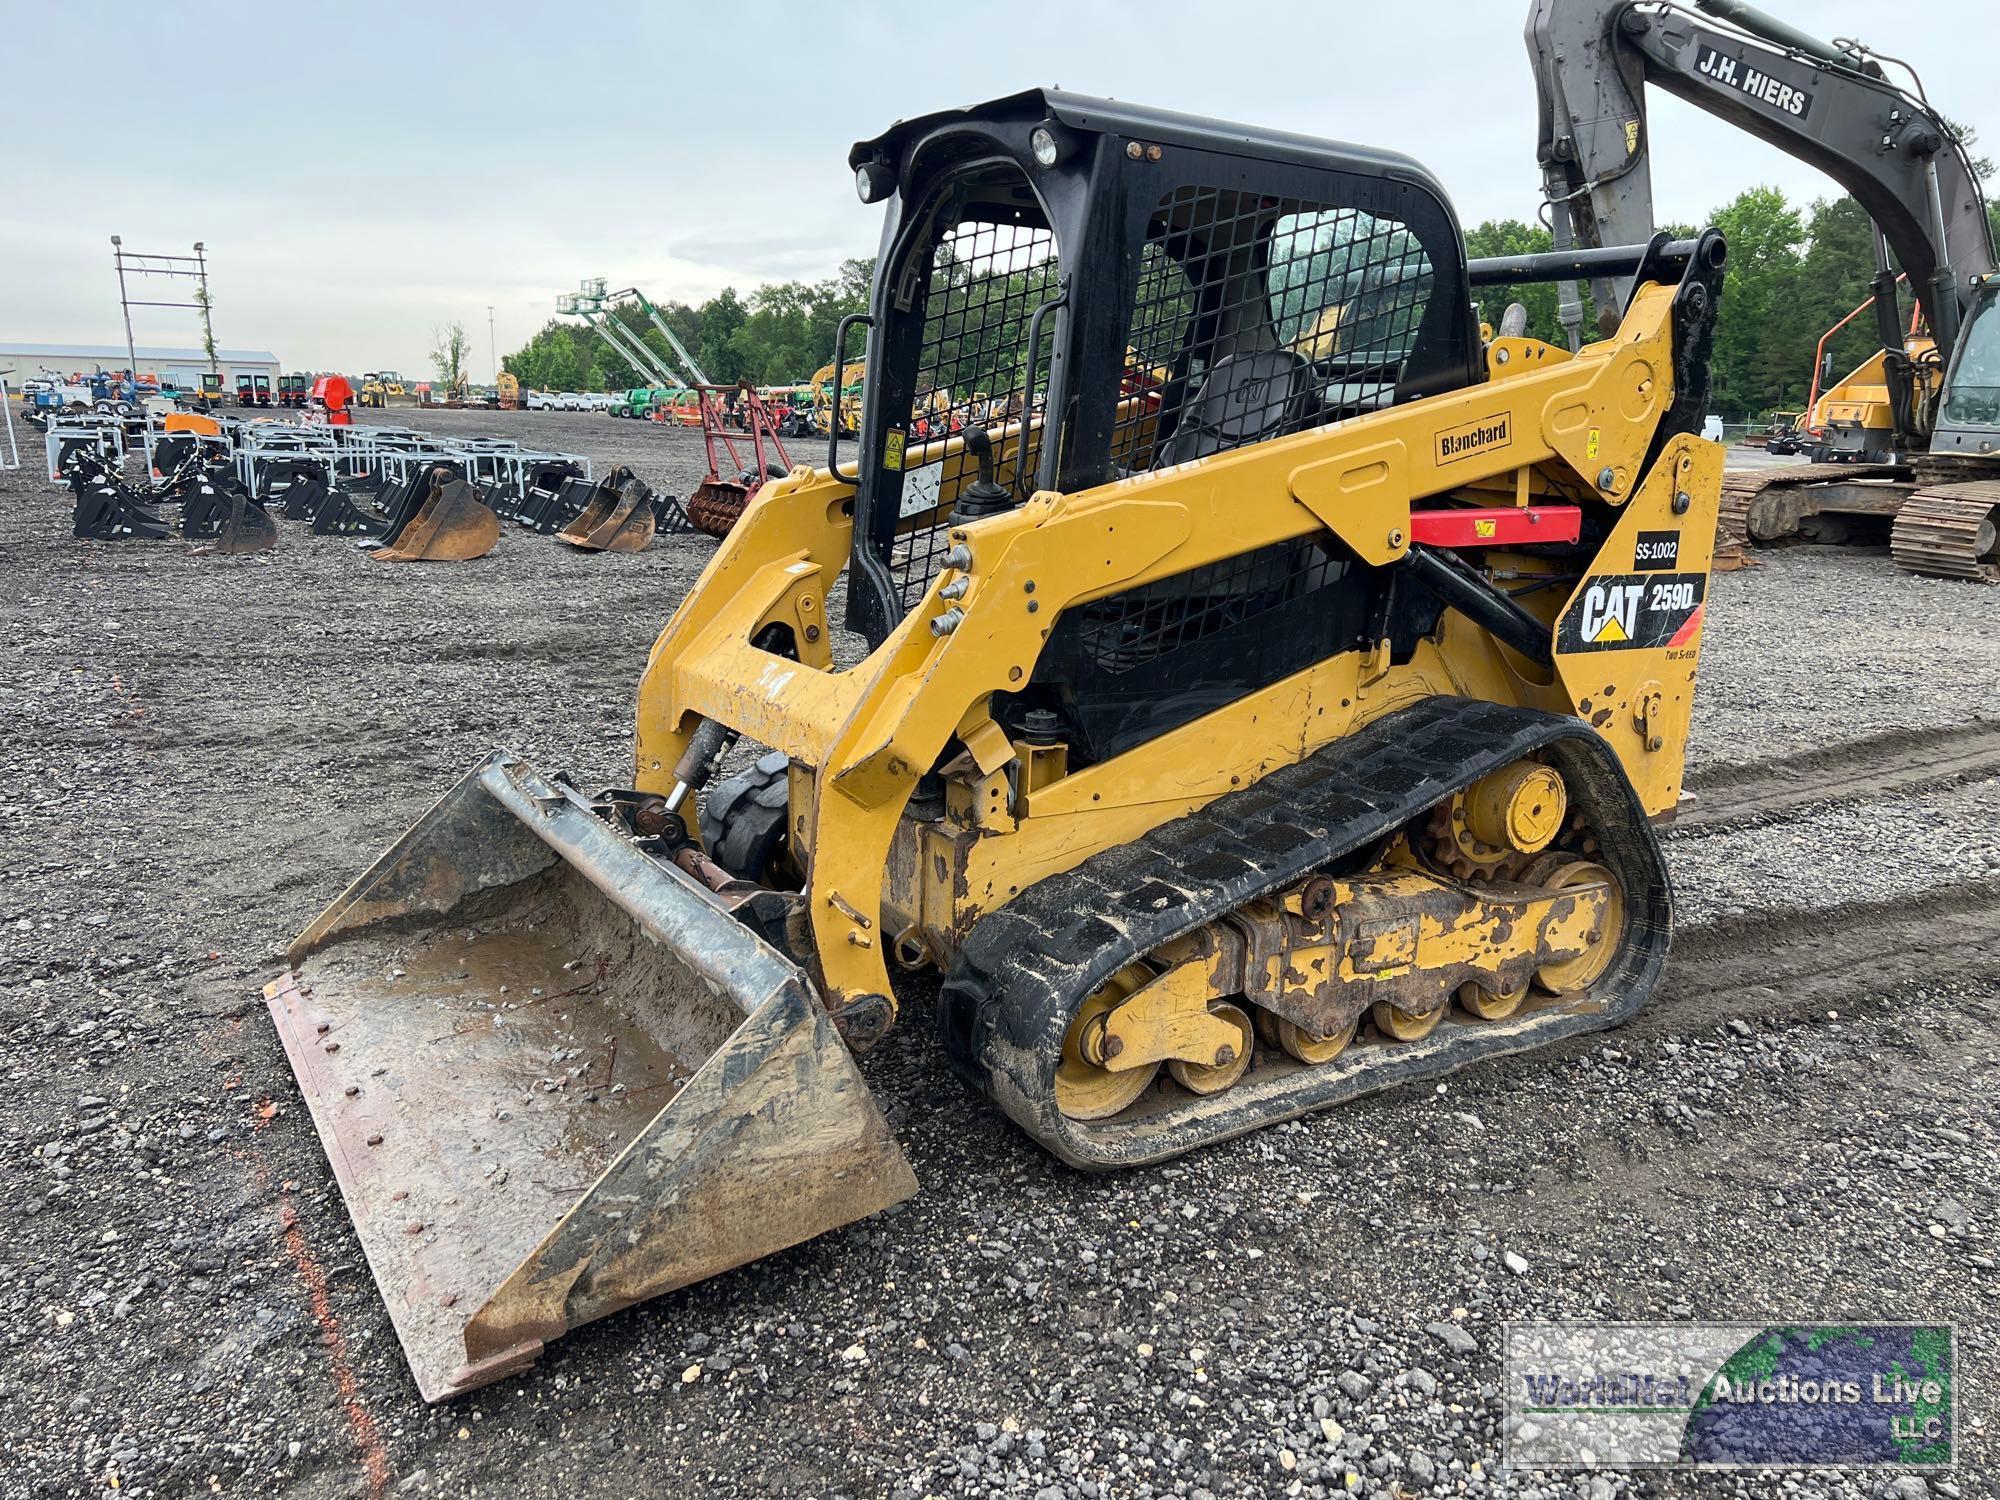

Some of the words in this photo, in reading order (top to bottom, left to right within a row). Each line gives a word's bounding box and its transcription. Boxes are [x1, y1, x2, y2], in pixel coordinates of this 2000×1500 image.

[1700, 51, 1738, 87] J.H.
[1743, 68, 1805, 115] HIERS
[1441, 420, 1507, 456] Blanchard
[1635, 541, 1677, 560] SS-1002
[1580, 584, 1644, 643] CAT
[1650, 583, 1694, 612] 259D
